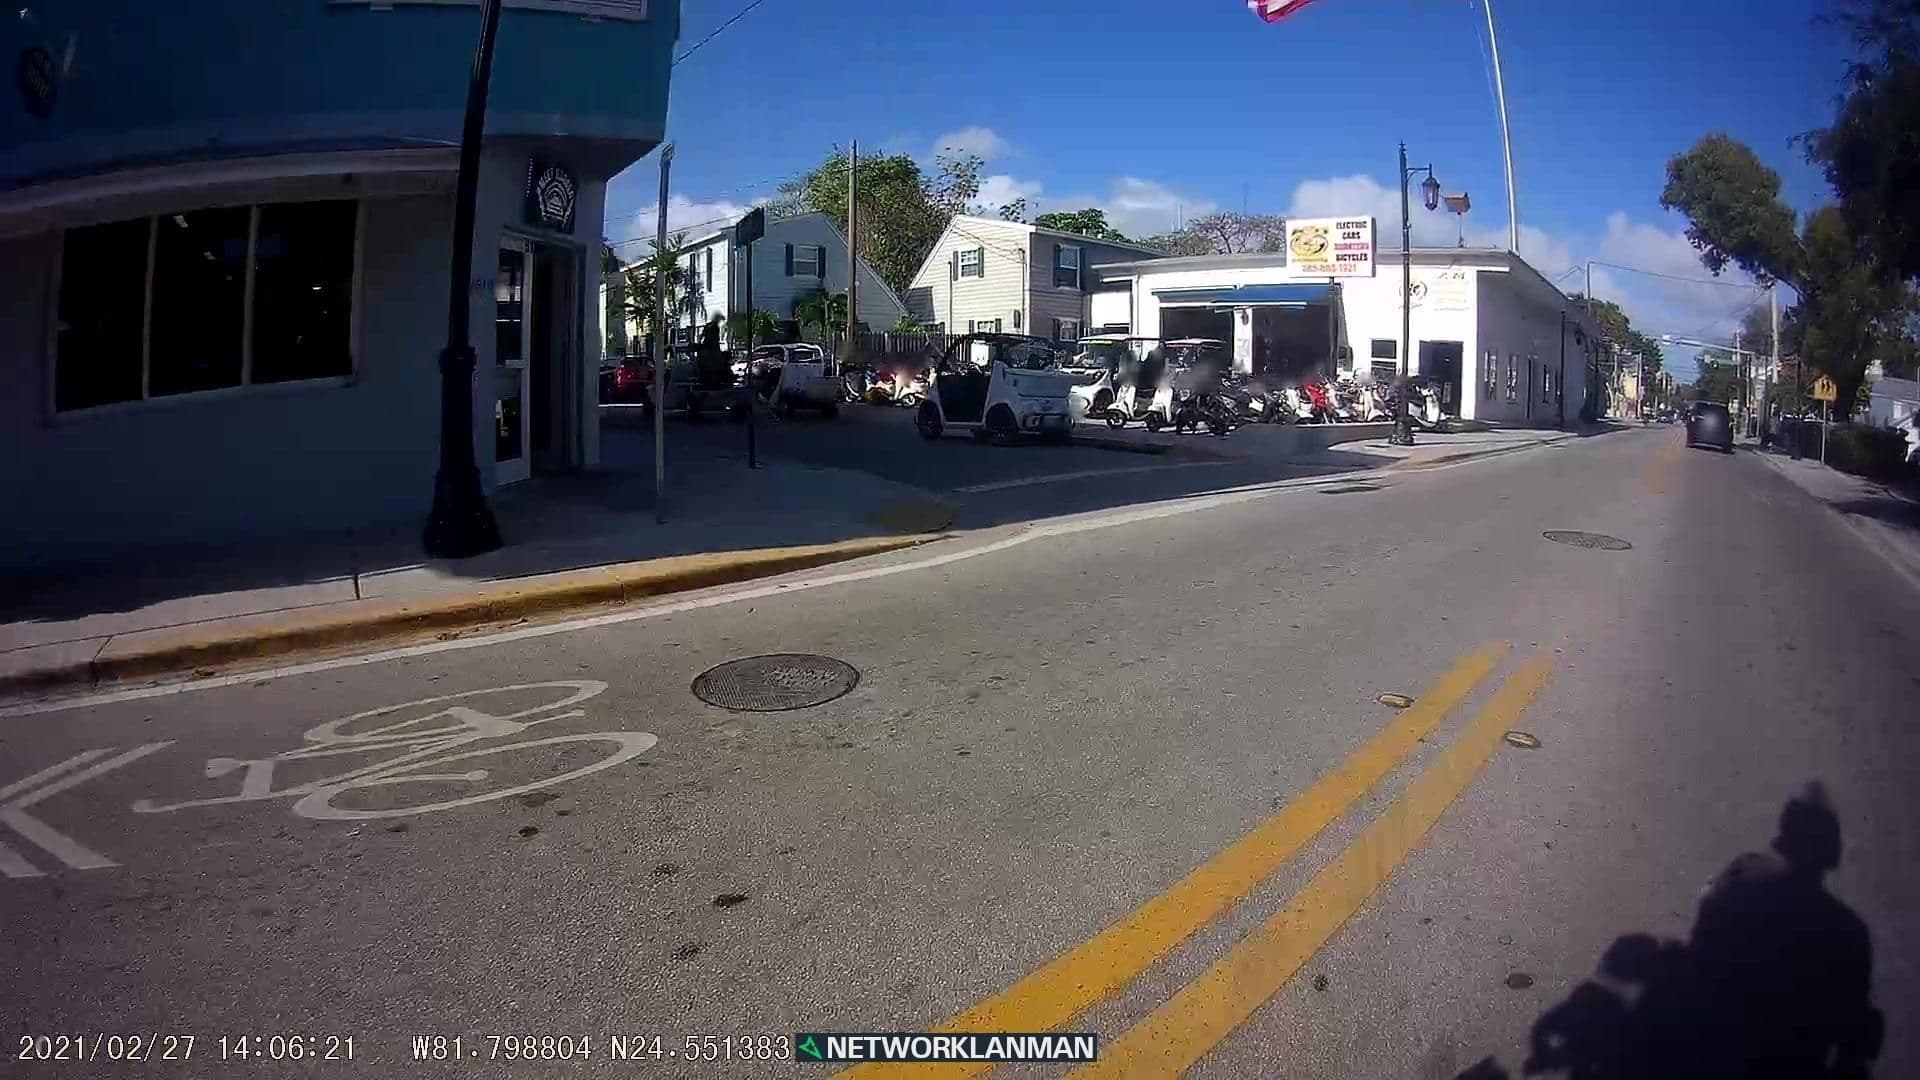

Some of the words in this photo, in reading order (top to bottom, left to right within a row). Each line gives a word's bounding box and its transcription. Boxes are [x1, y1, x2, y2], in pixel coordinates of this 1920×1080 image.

[1335, 221, 1368, 230] ELECTRIC
[1342, 231, 1361, 240] CARS
[1335, 252, 1368, 262] BICYCLES
